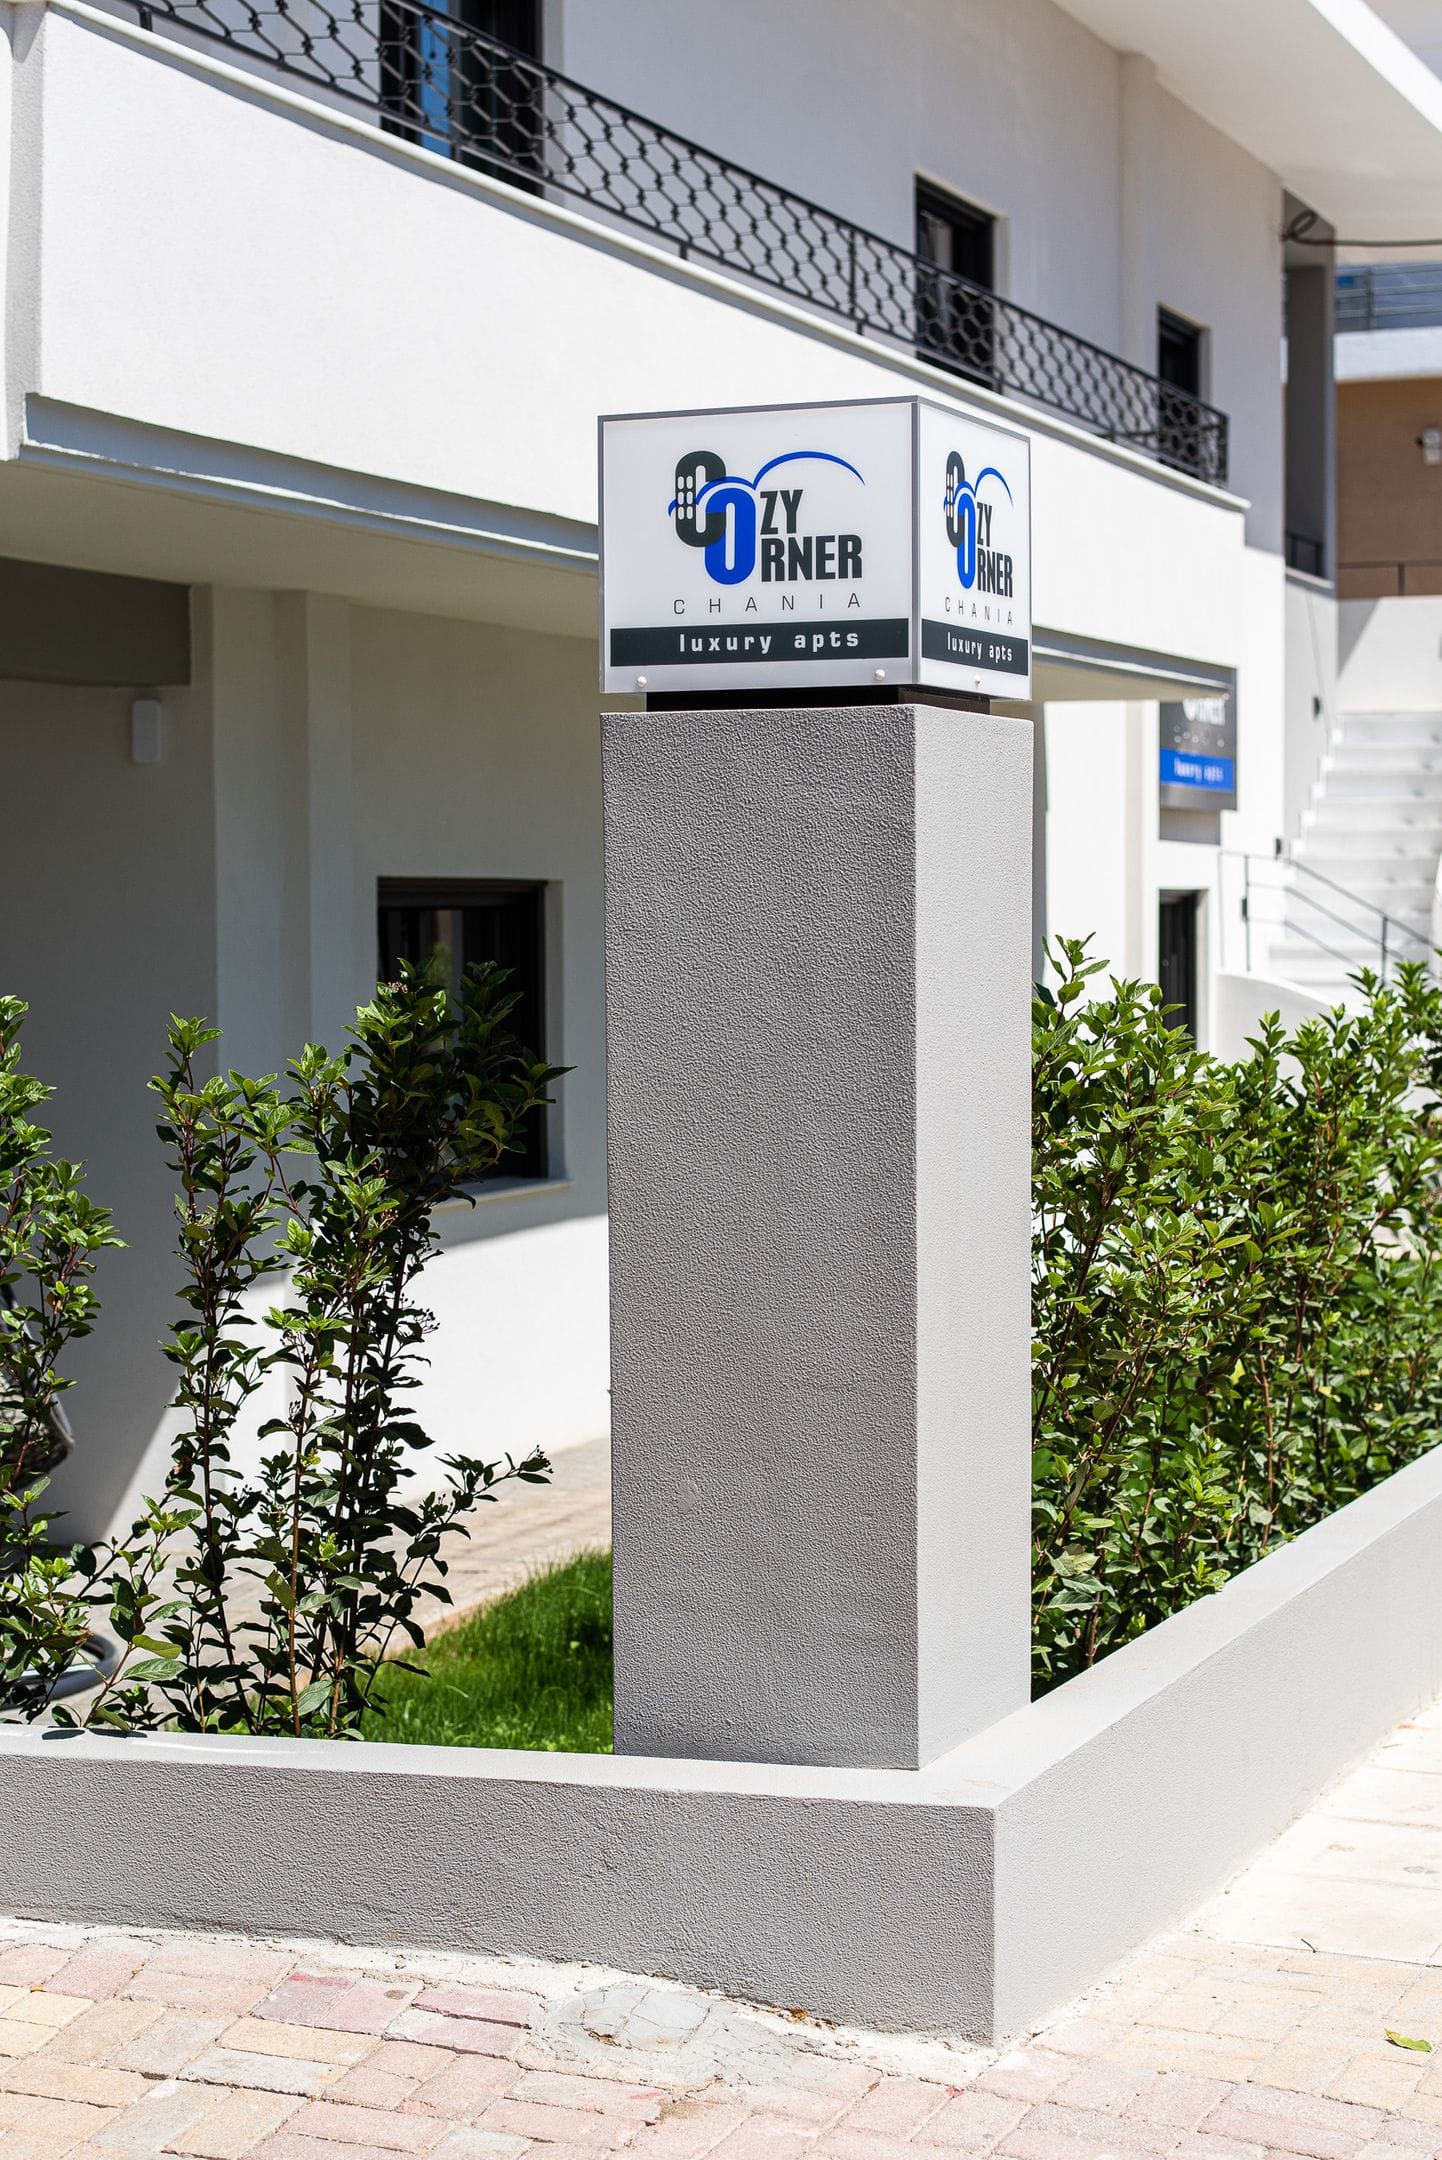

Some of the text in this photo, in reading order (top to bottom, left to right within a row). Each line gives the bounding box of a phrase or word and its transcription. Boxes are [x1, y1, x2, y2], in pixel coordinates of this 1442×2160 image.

[673, 592, 861, 615] CHANIA
[945, 597, 1013, 625] CHANIA
[679, 631, 859, 654] luxury apts
[947, 631, 1012, 662] luxury apts
